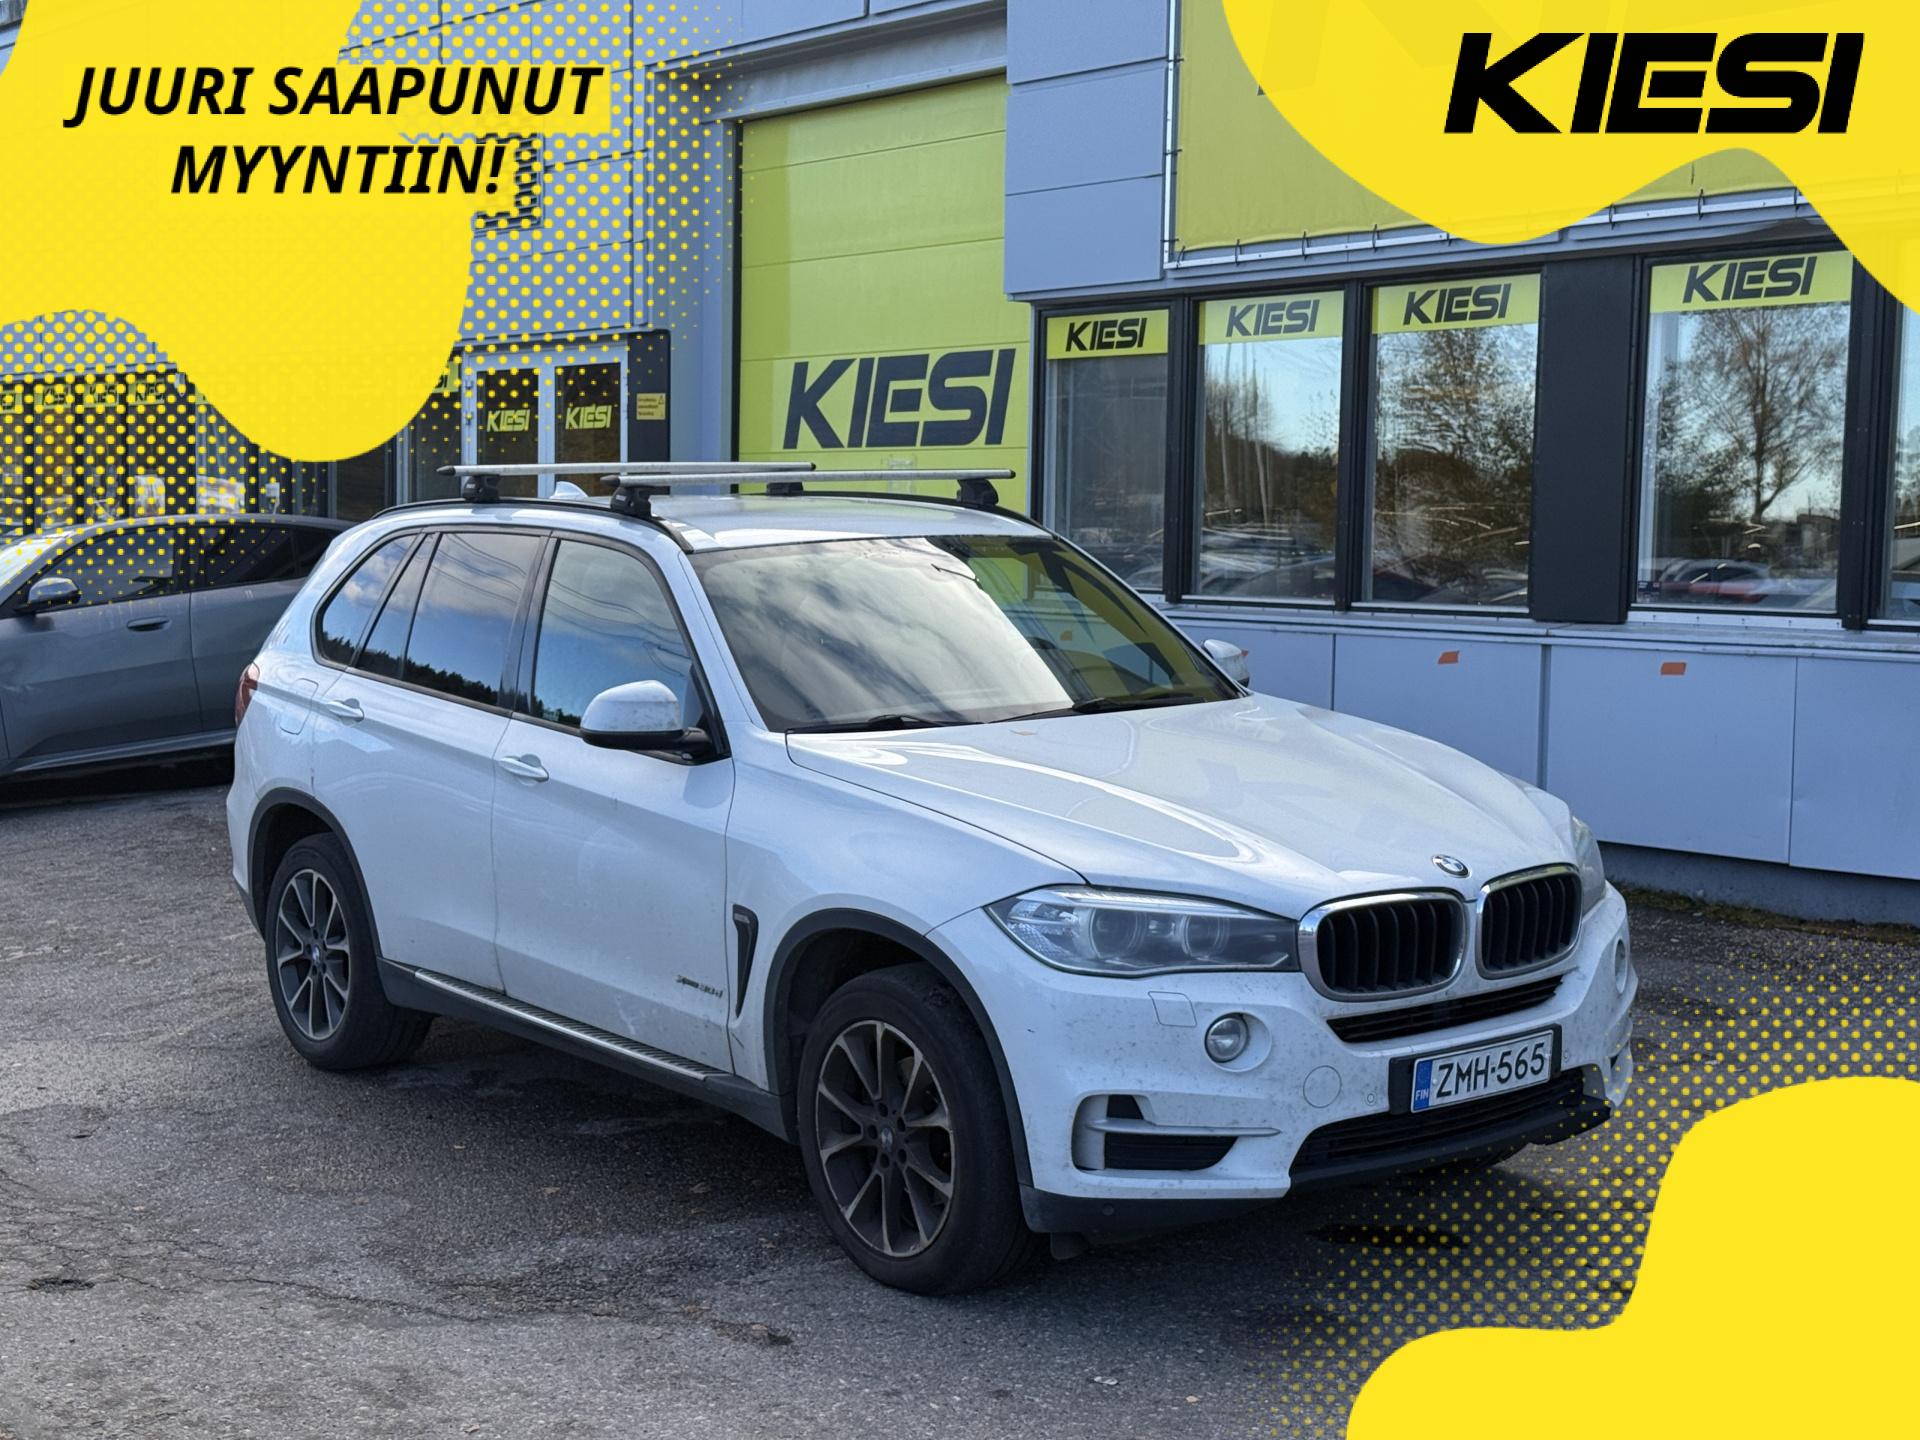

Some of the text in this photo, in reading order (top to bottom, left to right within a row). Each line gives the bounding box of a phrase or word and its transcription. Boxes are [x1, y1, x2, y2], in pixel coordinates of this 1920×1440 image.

[1682, 256, 1818, 304] KIESI
[1225, 299, 1321, 338] KIESI
[1402, 283, 1512, 326] KIESI
[1065, 317, 1148, 352] KIESI
[565, 404, 612, 430] KIESI
[783, 348, 1017, 450] KIESI
[486, 408, 531, 433] KIESI
[1436, 1042, 1545, 1098] ZMH-565
[1415, 1088, 1430, 1102] FIN
